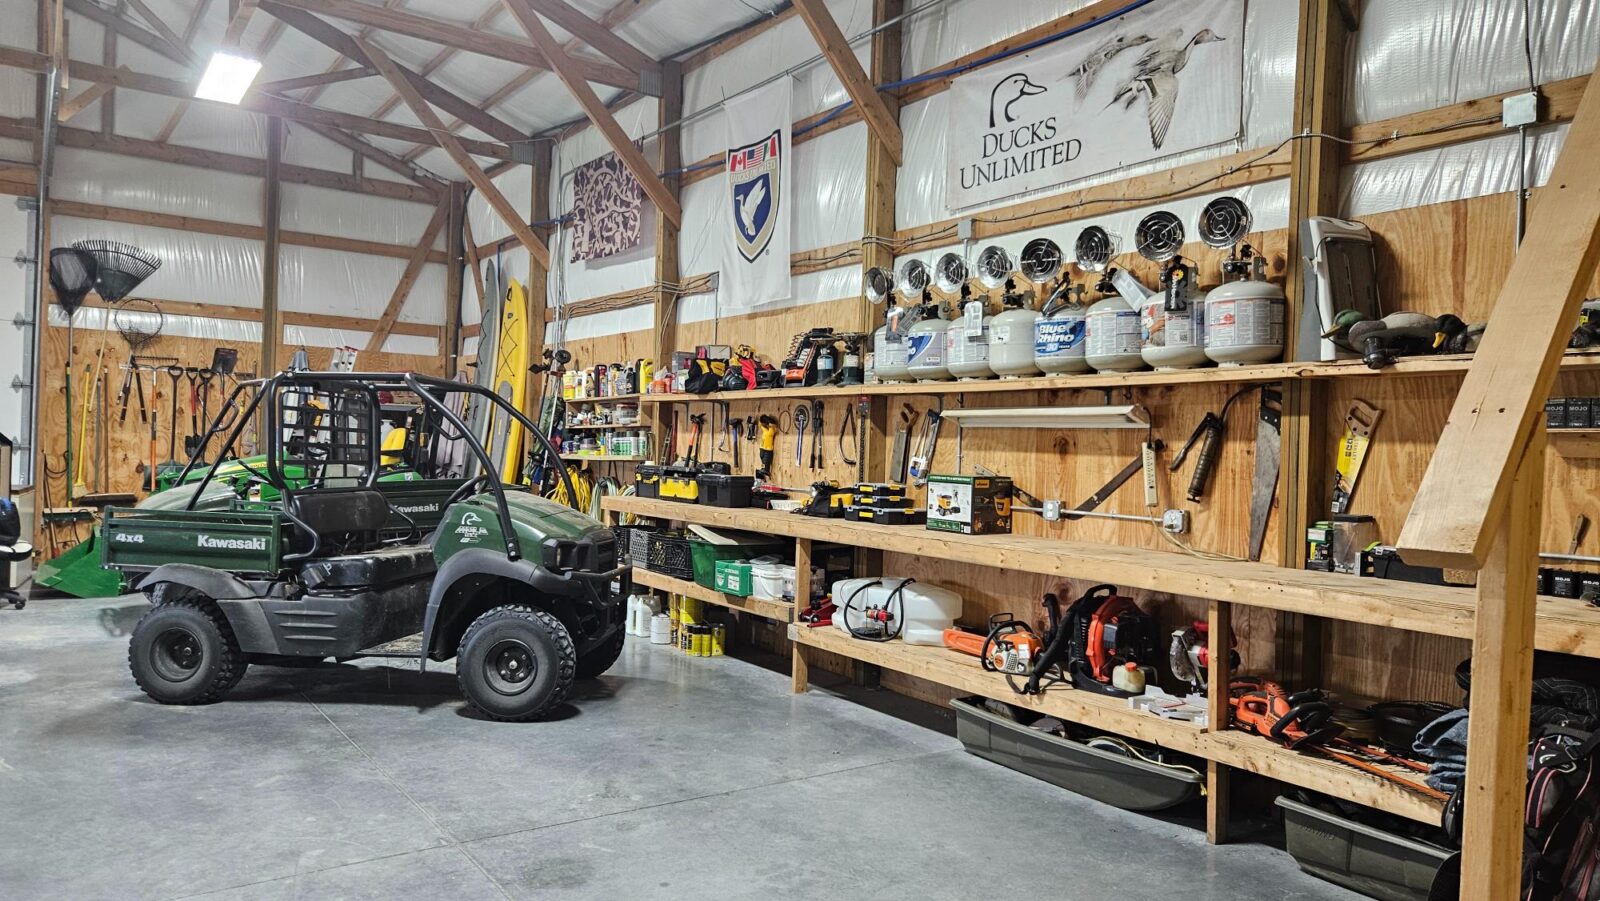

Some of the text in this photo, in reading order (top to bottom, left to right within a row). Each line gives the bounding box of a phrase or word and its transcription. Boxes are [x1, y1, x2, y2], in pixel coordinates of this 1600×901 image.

[982, 116, 1057, 159] DUCKS
[960, 138, 1082, 189] UNLIMITED
[1040, 324, 1066, 333] Blue
[1037, 333, 1074, 343] Rhino
[115, 533, 145, 544] 4x4
[197, 534, 266, 551] Kawasaki
